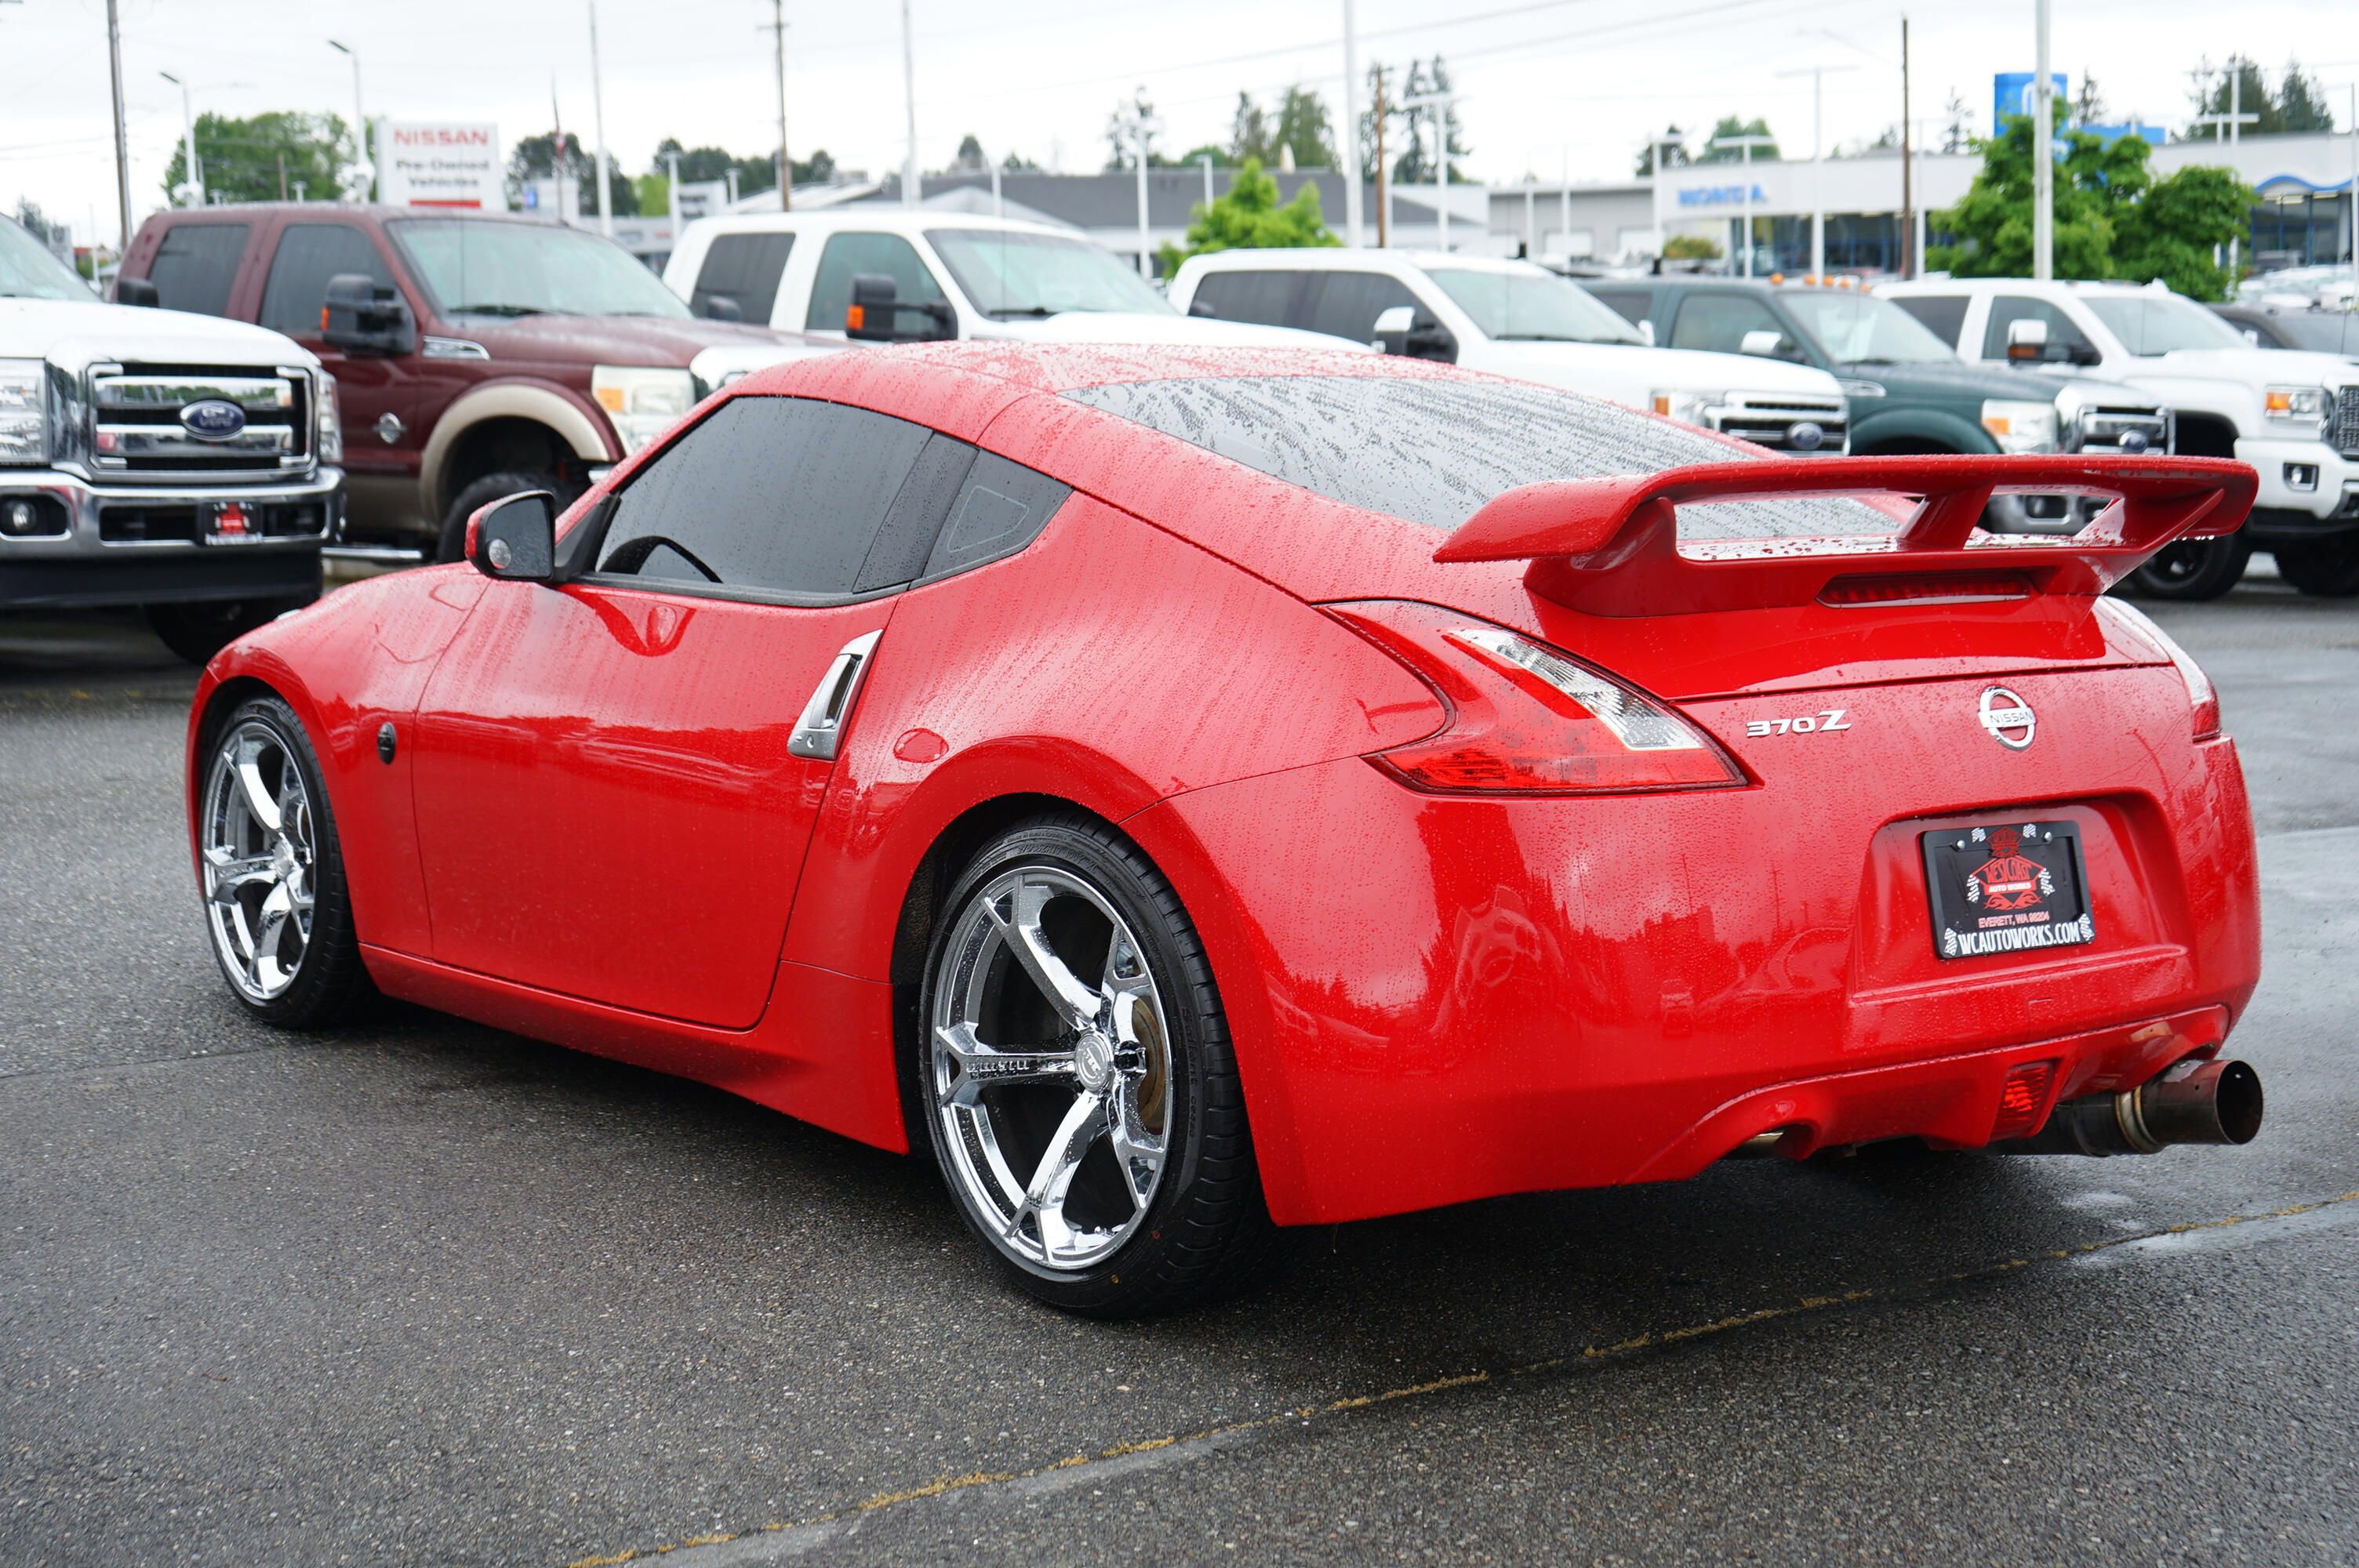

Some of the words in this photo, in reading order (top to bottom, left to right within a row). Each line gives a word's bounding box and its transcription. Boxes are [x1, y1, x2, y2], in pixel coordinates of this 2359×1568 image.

[394, 129, 489, 146] NISSAN
[1747, 710, 1852, 737] 370Z
[1990, 711, 2034, 724] NISSAN
[1957, 921, 2081, 955] WCAUTOWORKS.COM
